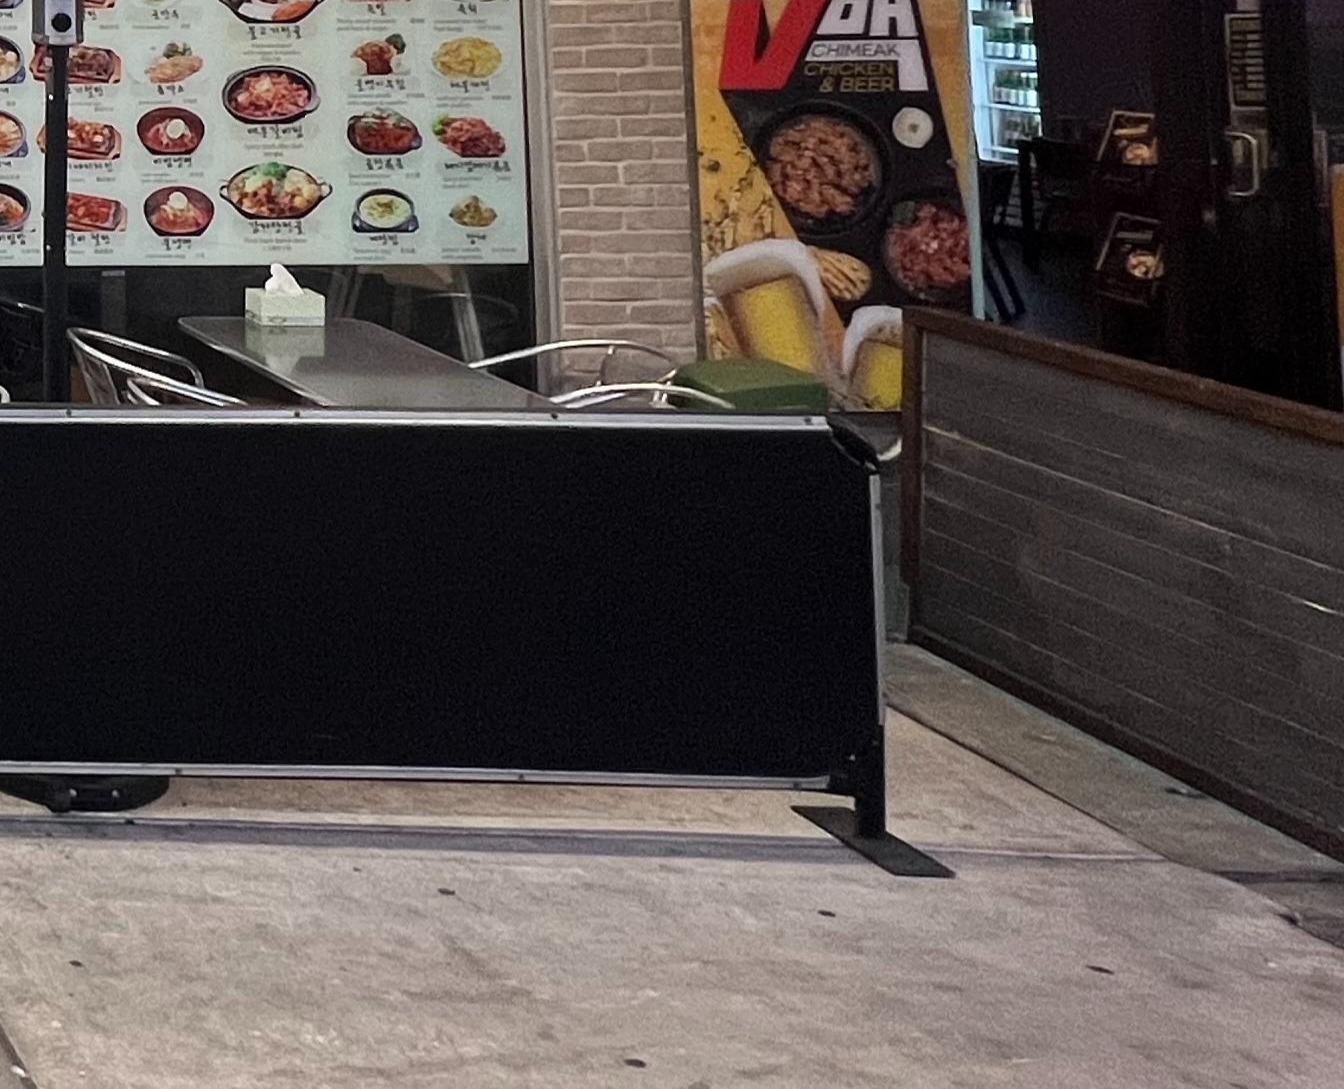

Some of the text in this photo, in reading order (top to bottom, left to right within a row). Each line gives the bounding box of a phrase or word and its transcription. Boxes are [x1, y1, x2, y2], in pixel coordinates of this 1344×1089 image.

[811, 43, 901, 59] CHIMEAK
[804, 61, 895, 76] CHICKEN
[840, 76, 896, 92] BEER
